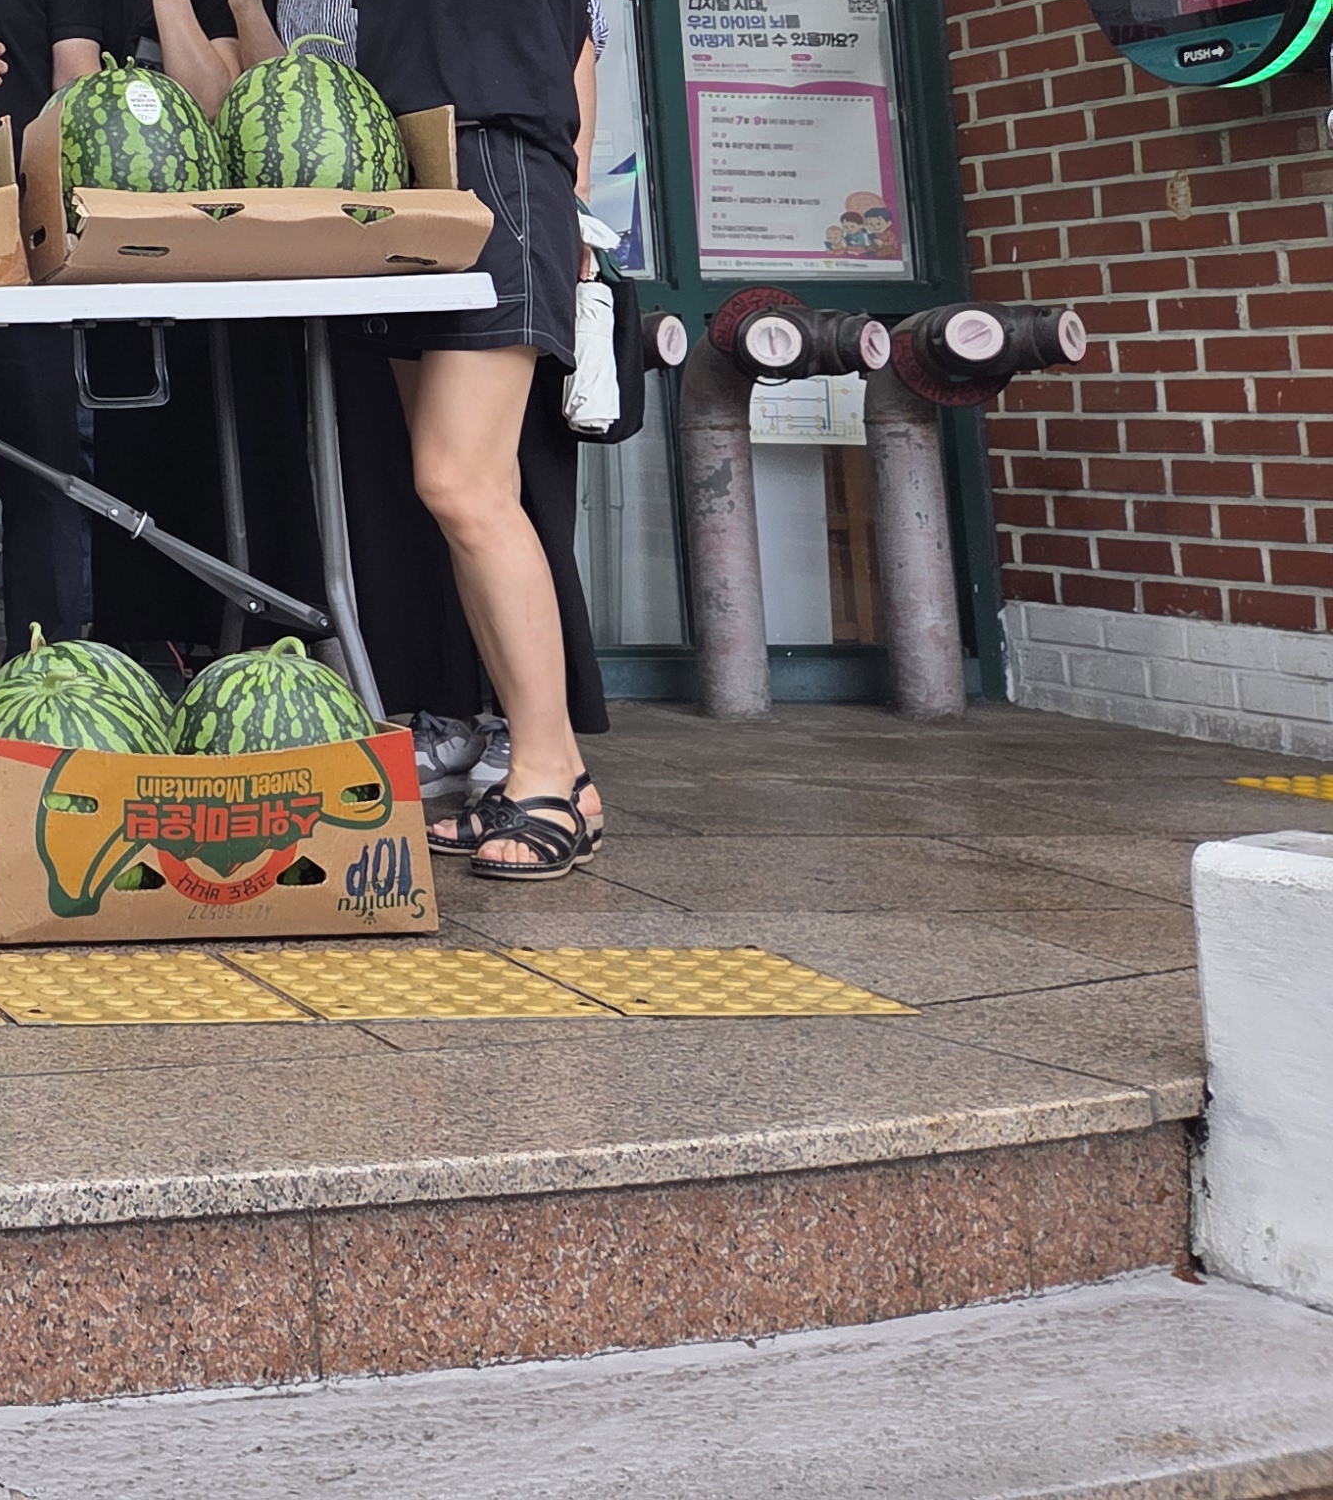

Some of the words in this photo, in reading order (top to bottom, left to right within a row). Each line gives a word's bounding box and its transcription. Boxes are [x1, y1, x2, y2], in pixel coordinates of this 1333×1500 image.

[687, 15, 716, 29] 우리
[720, 15, 766, 29] 아이의
[770, 15, 801, 29] 뇌를
[690, 33, 734, 48] 어떻게
[737, 34, 768, 48] 지킬
[772, 34, 788, 47] 수
[791, 33, 859, 48] 있을까요?
[1183, 48, 1211, 63] PUSH
[139, 776, 244, 802] Mountain
[250, 769, 312, 796] Sweet
[126, 797, 322, 842] 스위트마운틴
[177, 873, 220, 900] 바나나
[227, 871, 276, 900] 고당도
[338, 887, 427, 919] Sumifru
